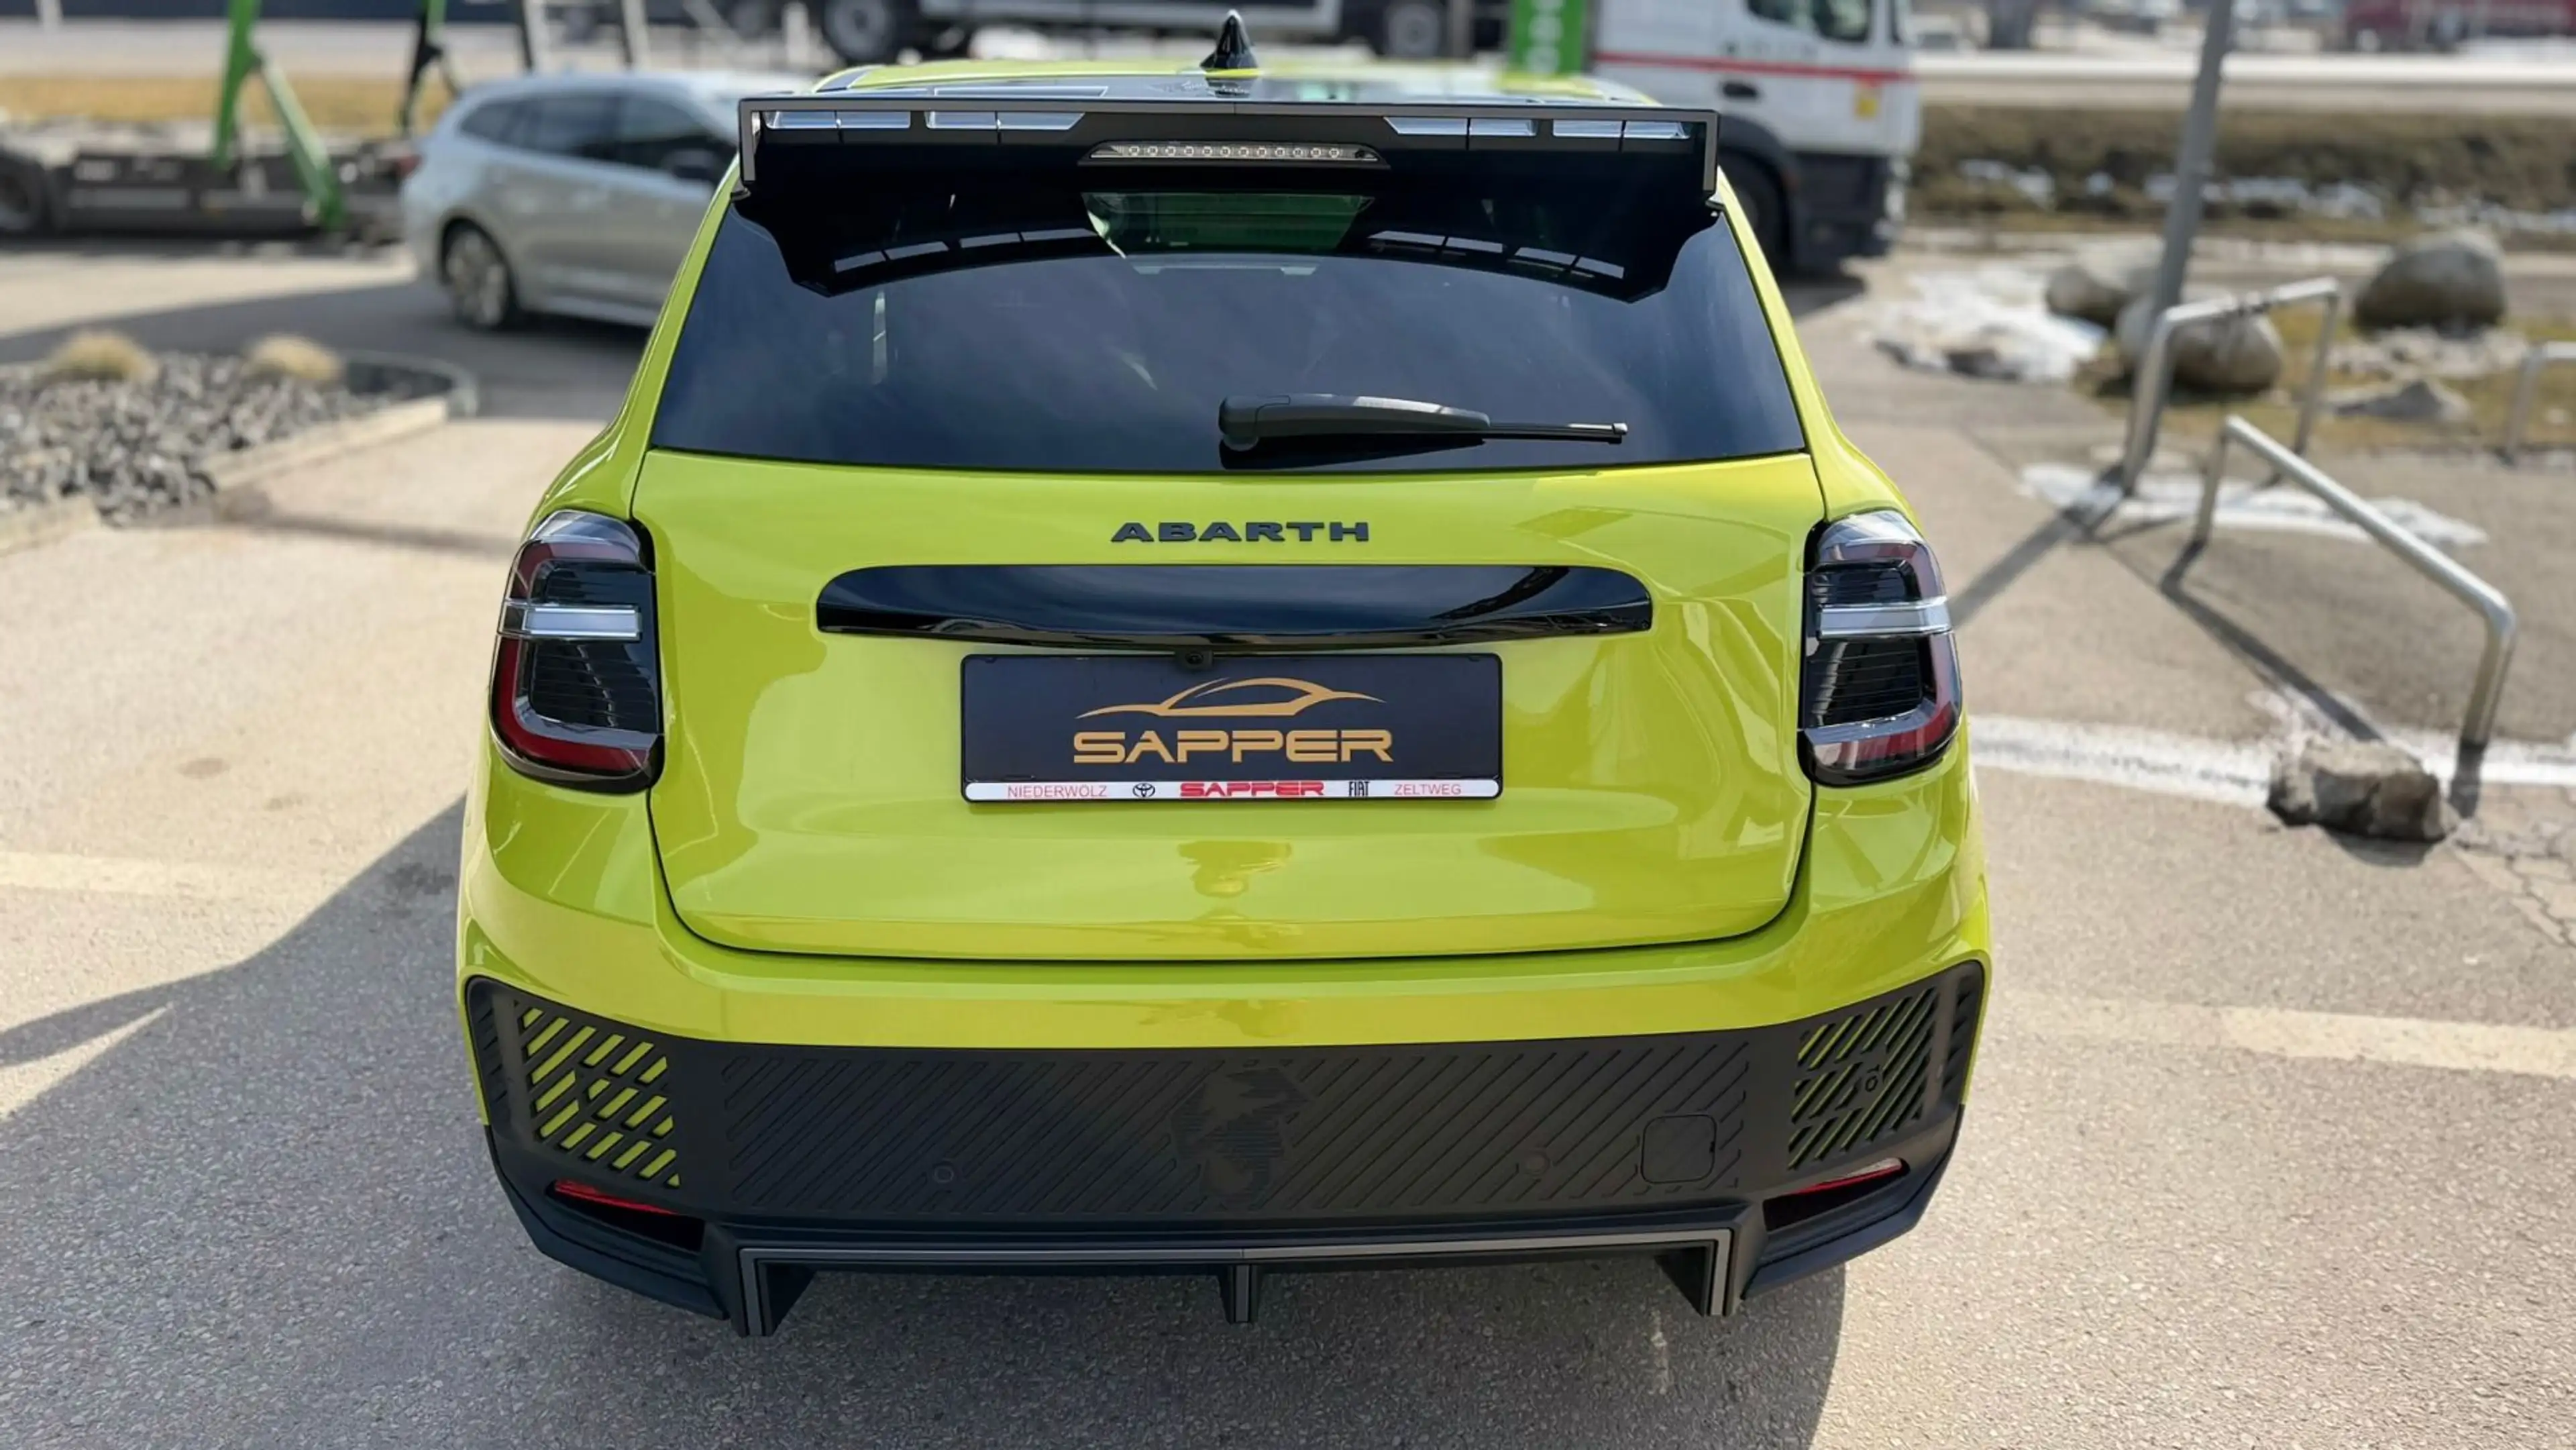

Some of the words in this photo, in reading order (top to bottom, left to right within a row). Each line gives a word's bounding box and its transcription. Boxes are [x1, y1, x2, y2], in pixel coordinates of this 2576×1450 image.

[1111, 522, 1369, 542] ABARTH
[1073, 730, 1394, 763] SAPPER
[1180, 782, 1325, 797] SAPPER
[1349, 781, 1369, 797] FIAT
[1394, 784, 1461, 796] ZELTWEG
